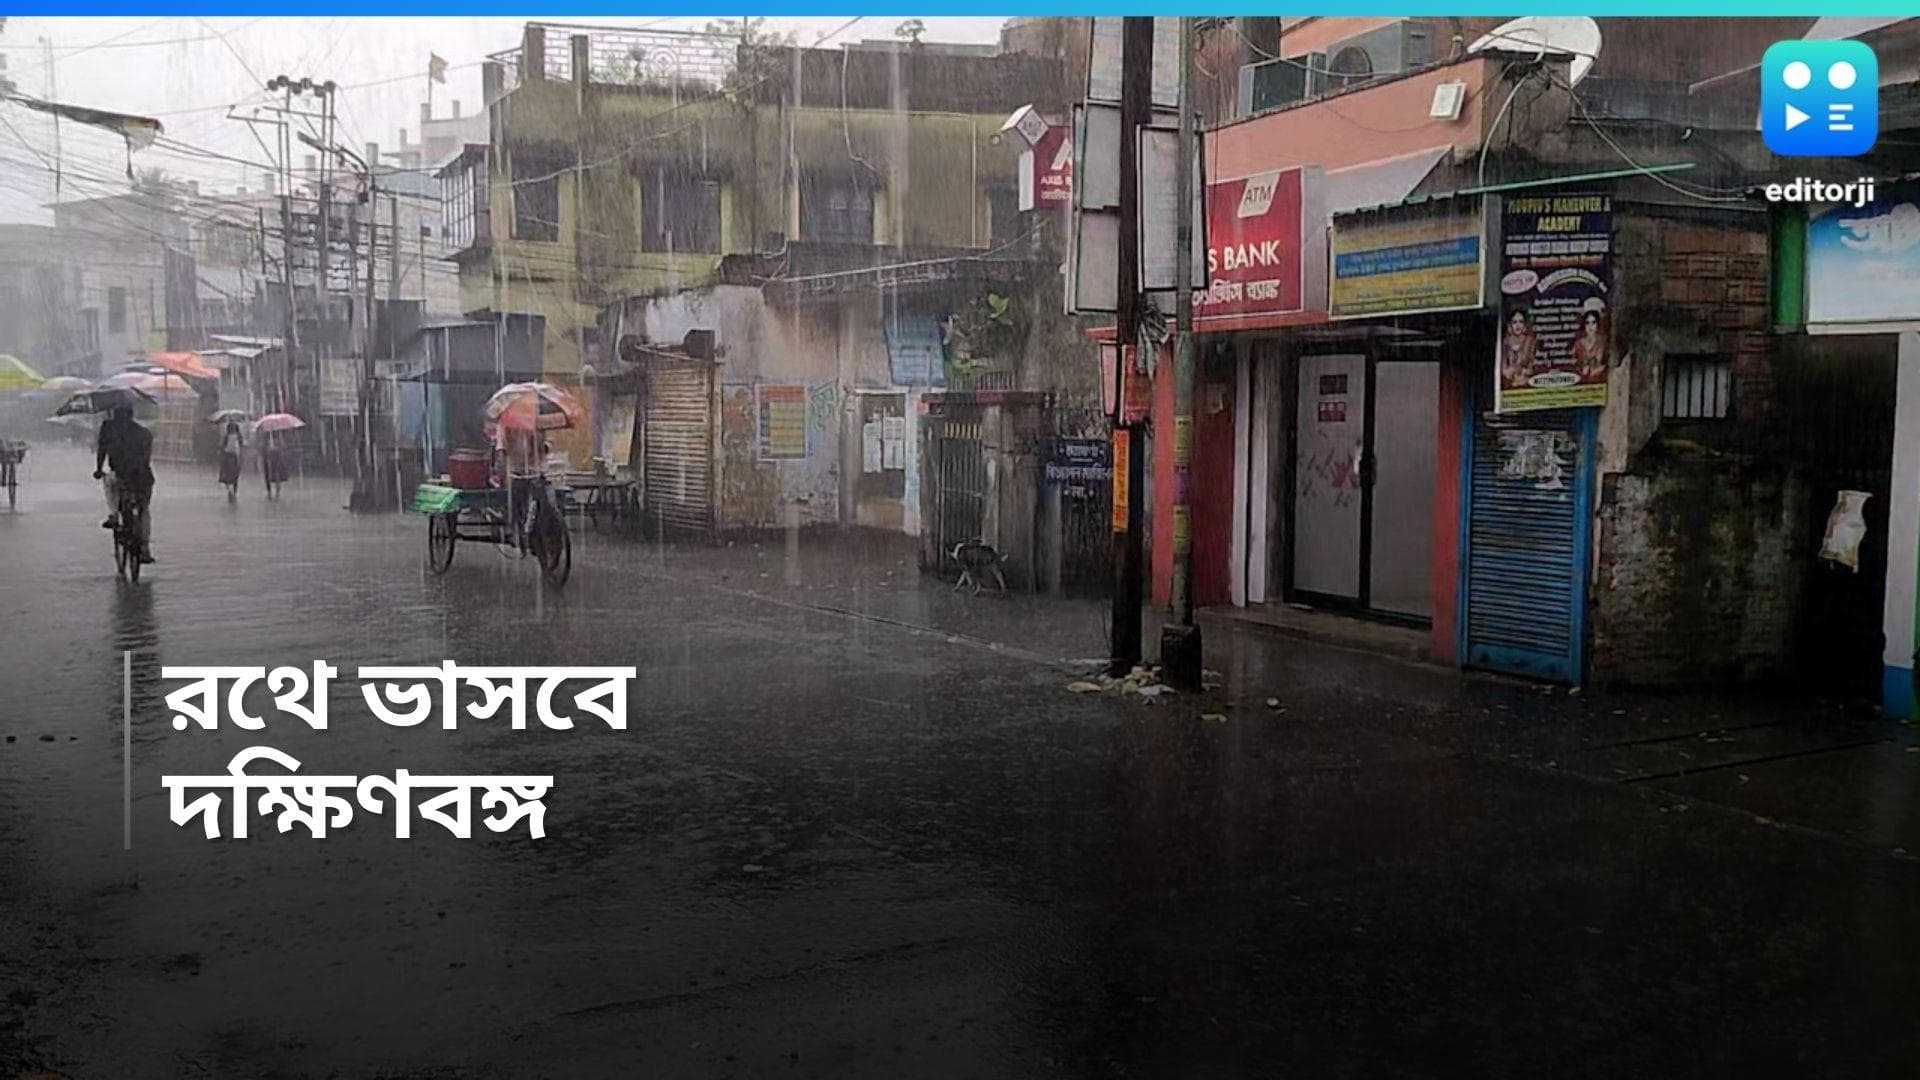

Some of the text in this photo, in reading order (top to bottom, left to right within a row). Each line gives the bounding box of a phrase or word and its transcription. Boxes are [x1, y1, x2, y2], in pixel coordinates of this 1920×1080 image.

[1245, 184, 1272, 203] ATM
[1537, 215, 1581, 232] ACADEMY
[1224, 240, 1280, 271] BANK
